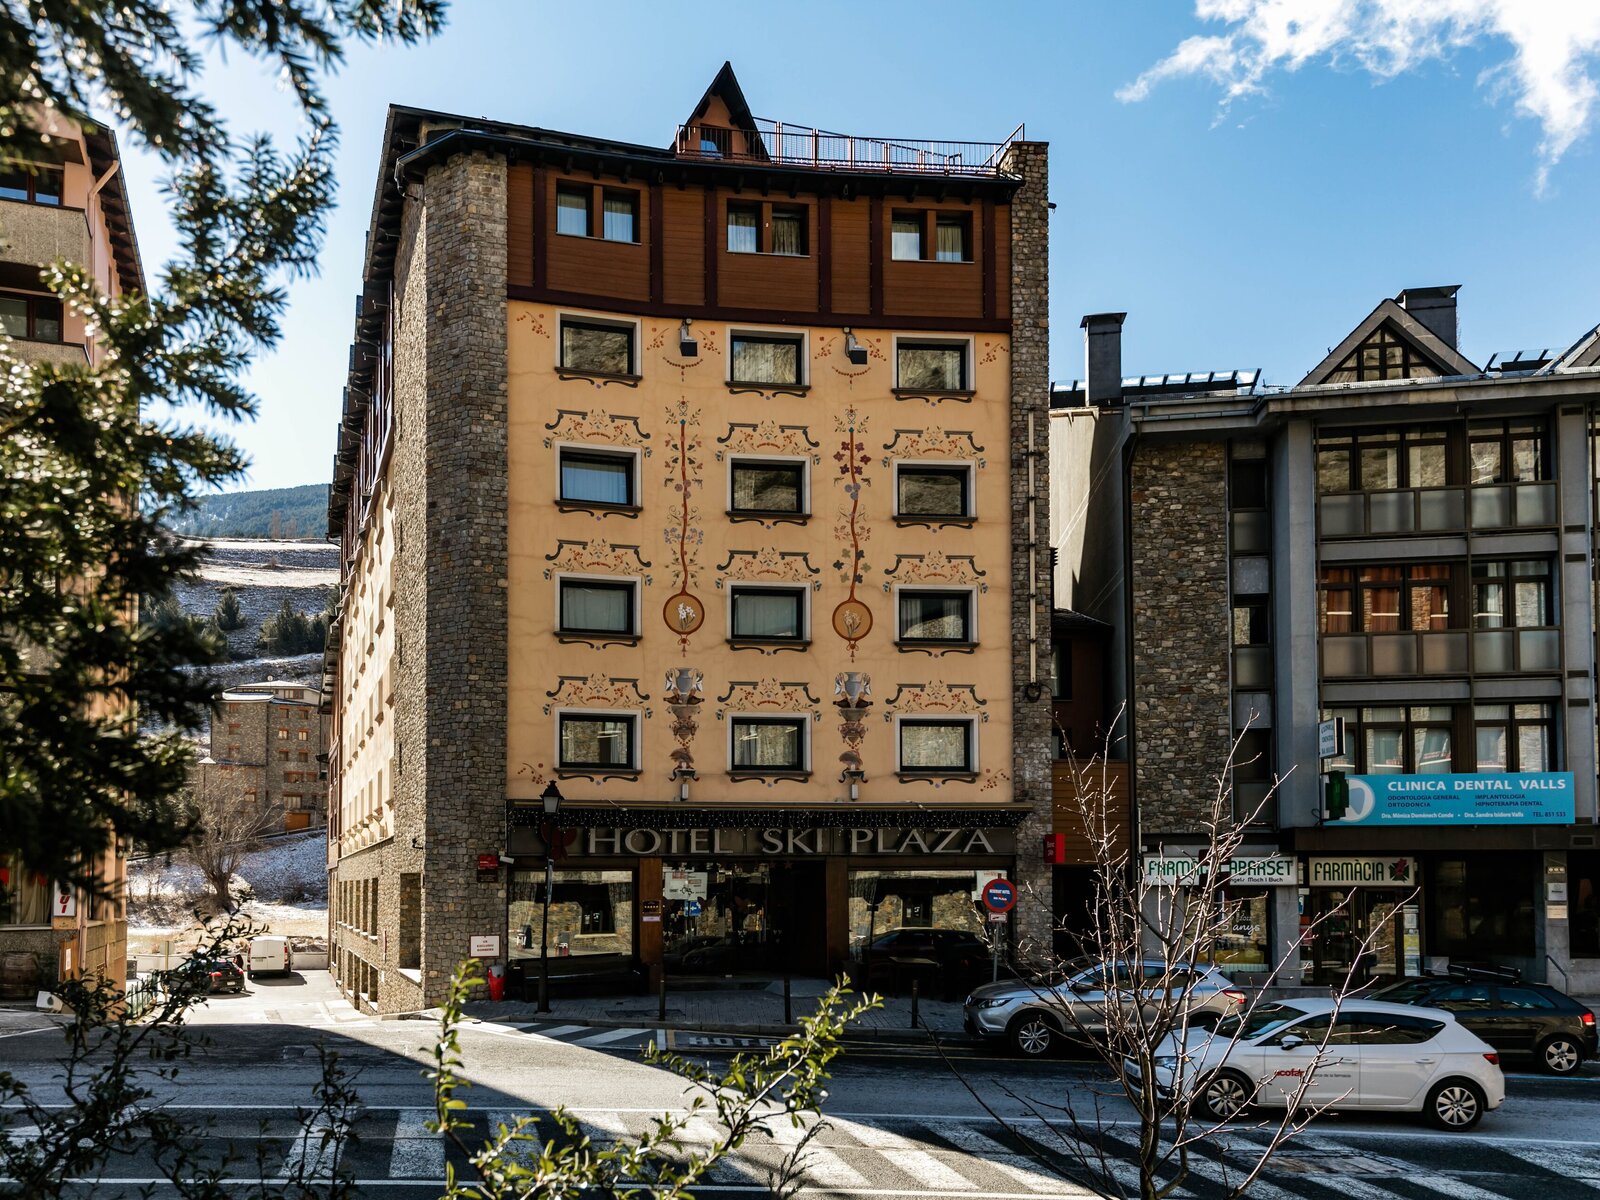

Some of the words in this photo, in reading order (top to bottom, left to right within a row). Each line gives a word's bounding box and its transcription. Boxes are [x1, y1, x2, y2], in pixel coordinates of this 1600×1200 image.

[1387, 780, 1447, 792] CLINICA
[1454, 779, 1513, 791] DENTAL
[1519, 778, 1567, 790] VALLS
[588, 828, 734, 854] HOTEL
[762, 828, 823, 854] SKI
[850, 828, 995, 853] PLAZA
[1314, 859, 1385, 881] FARMÀCIA
[1232, 923, 1261, 935] anys
